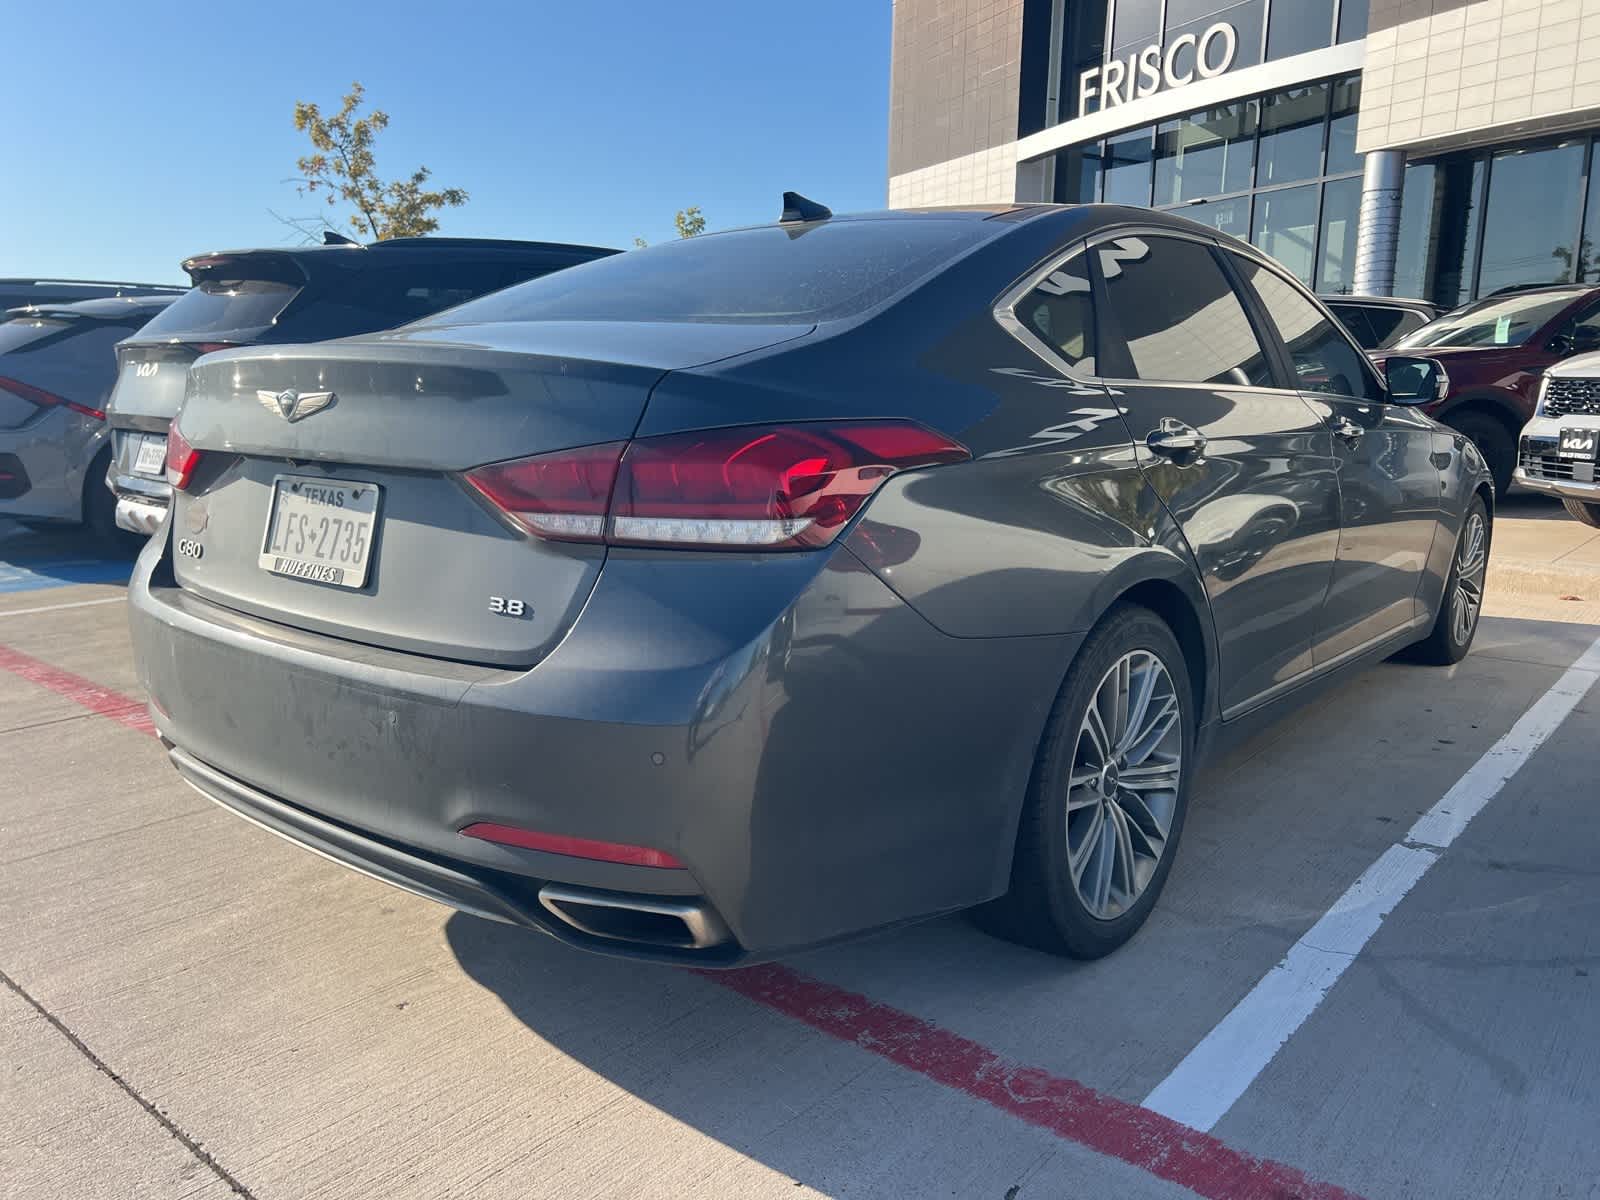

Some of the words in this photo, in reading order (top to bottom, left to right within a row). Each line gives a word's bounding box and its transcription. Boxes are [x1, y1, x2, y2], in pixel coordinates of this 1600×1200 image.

[1079, 22, 1236, 118] FRISCO
[305, 487, 344, 507] TEXAS
[179, 538, 201, 558] G80
[279, 559, 338, 582] HUFFINES
[488, 596, 524, 616] 3.8
